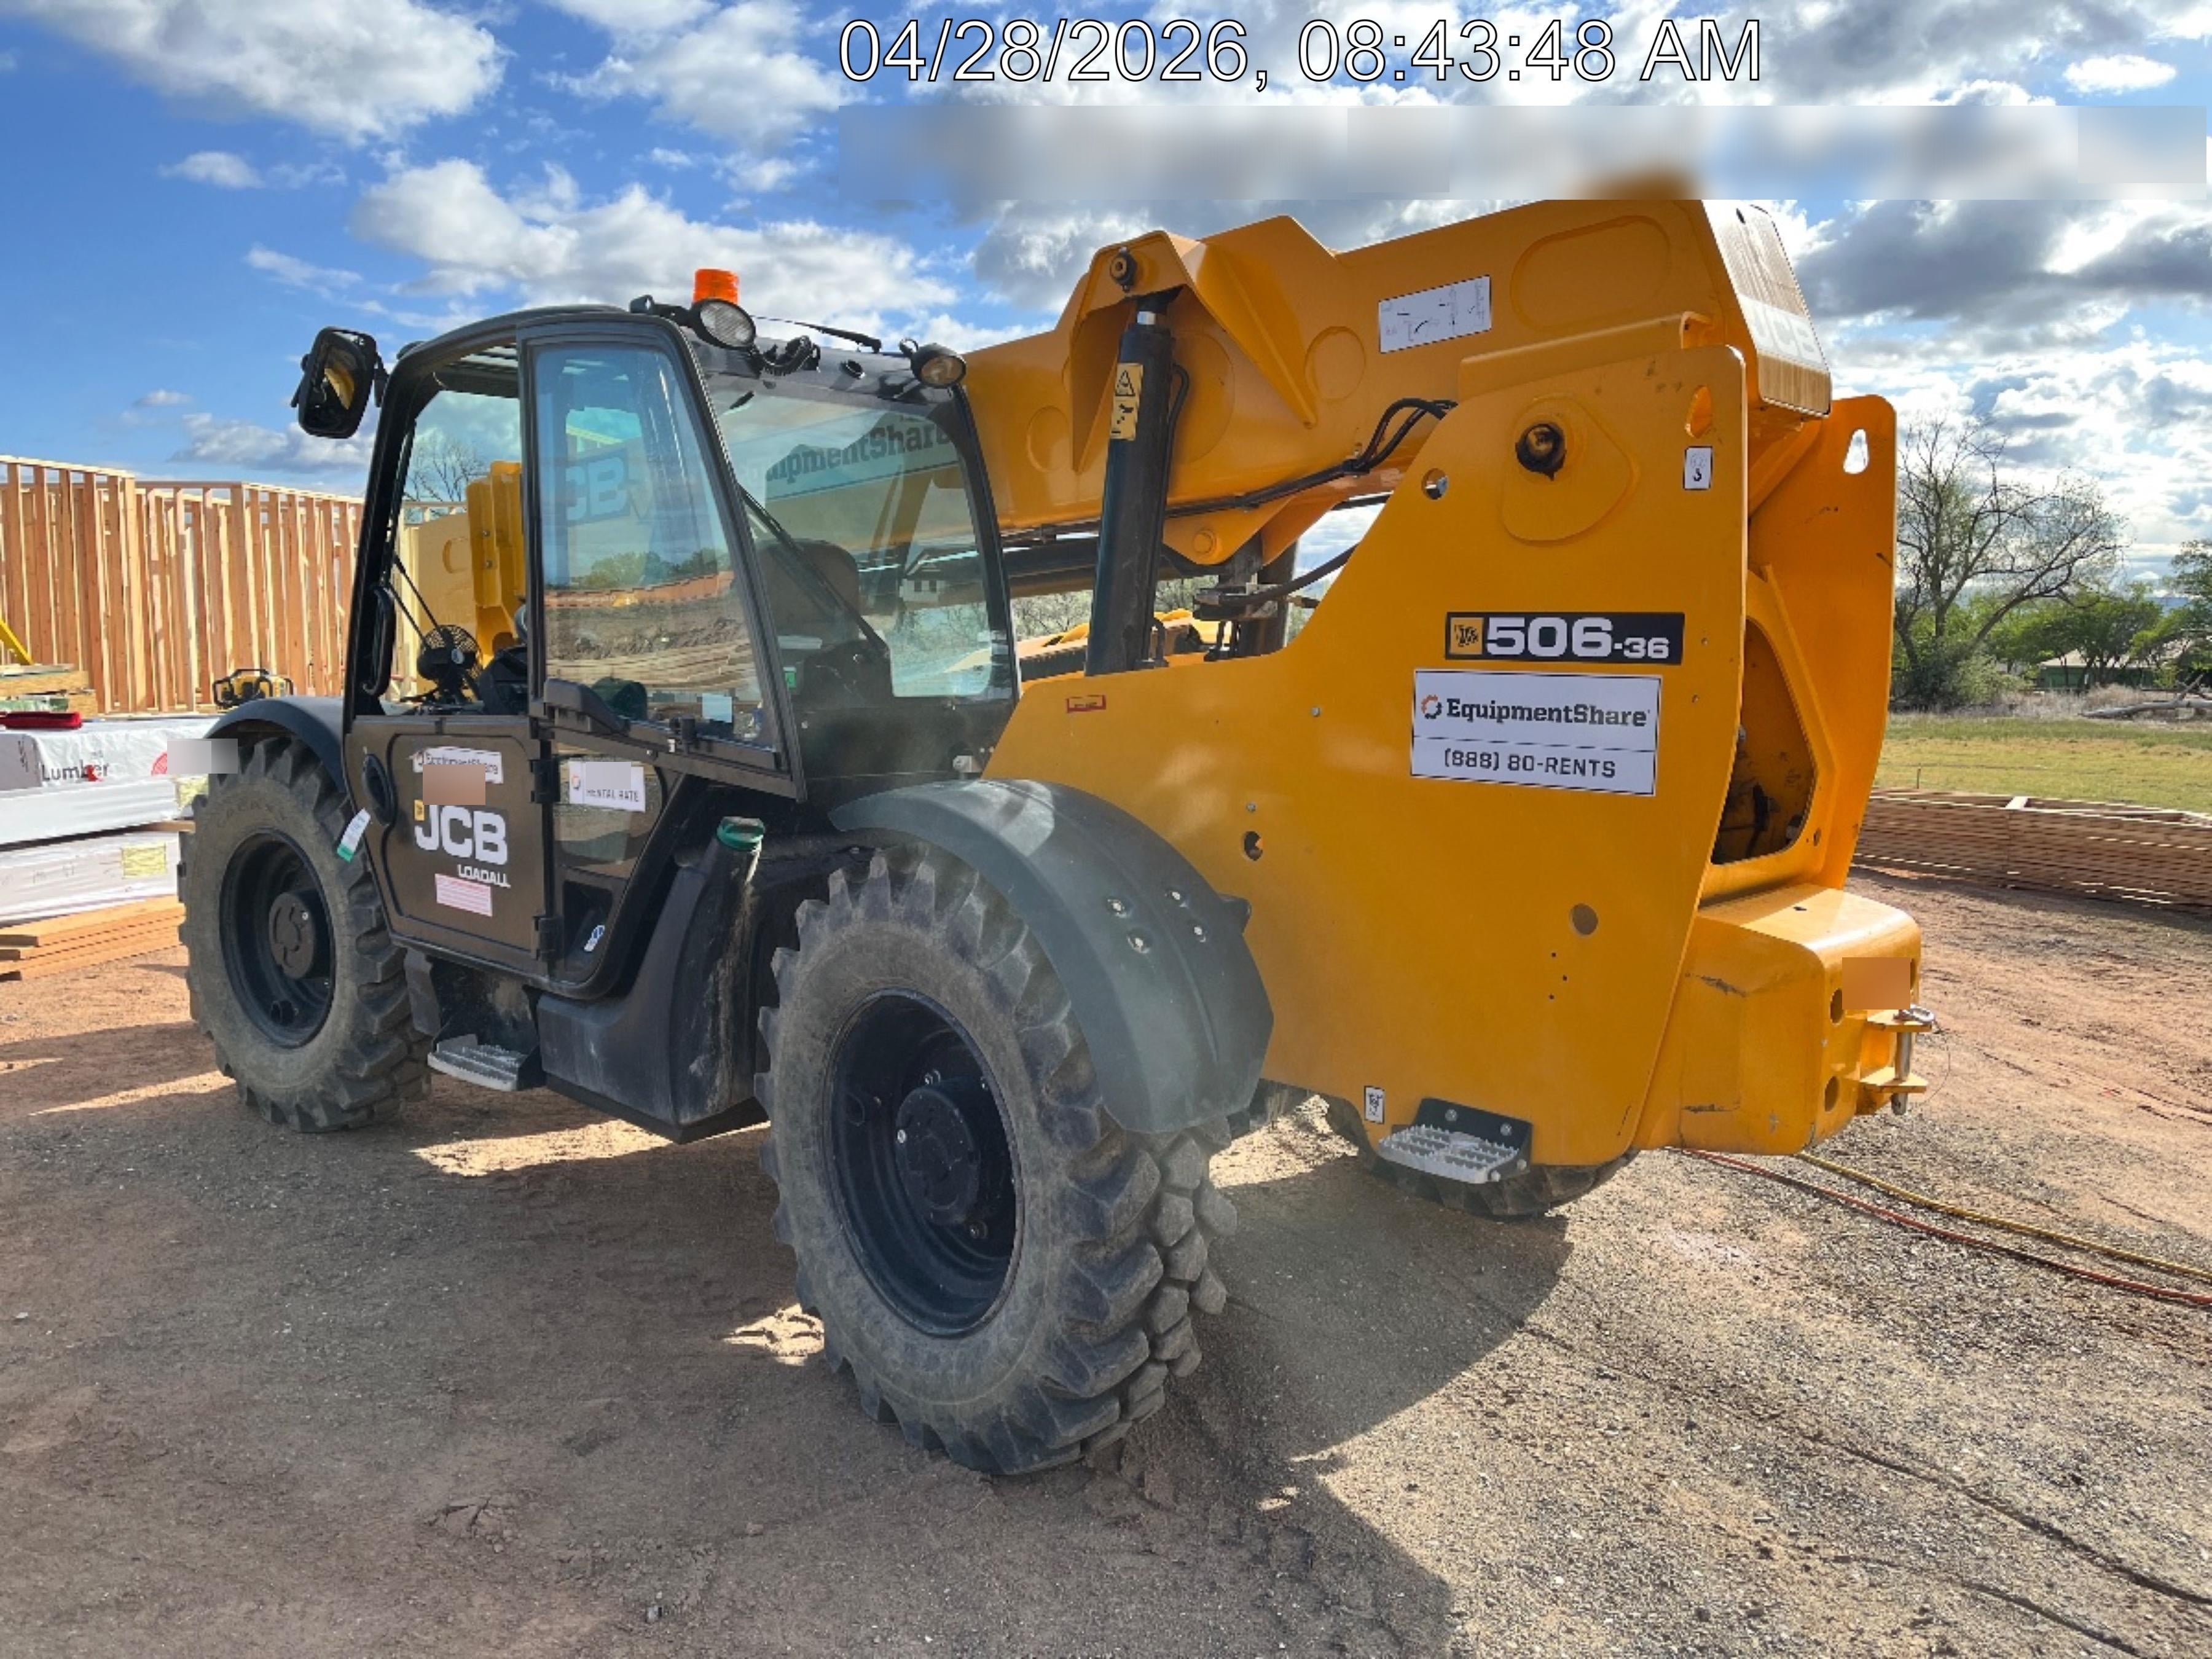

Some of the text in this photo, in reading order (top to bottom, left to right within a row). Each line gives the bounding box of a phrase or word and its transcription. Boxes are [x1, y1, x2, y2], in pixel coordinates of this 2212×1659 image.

[1486, 617, 1669, 659] 506-36
[1447, 698, 1647, 726] EquipmentShare
[1445, 748, 1616, 778] (888) 80-RENTS
[415, 805, 508, 865] JCB
[457, 864, 511, 888] LOADALL
